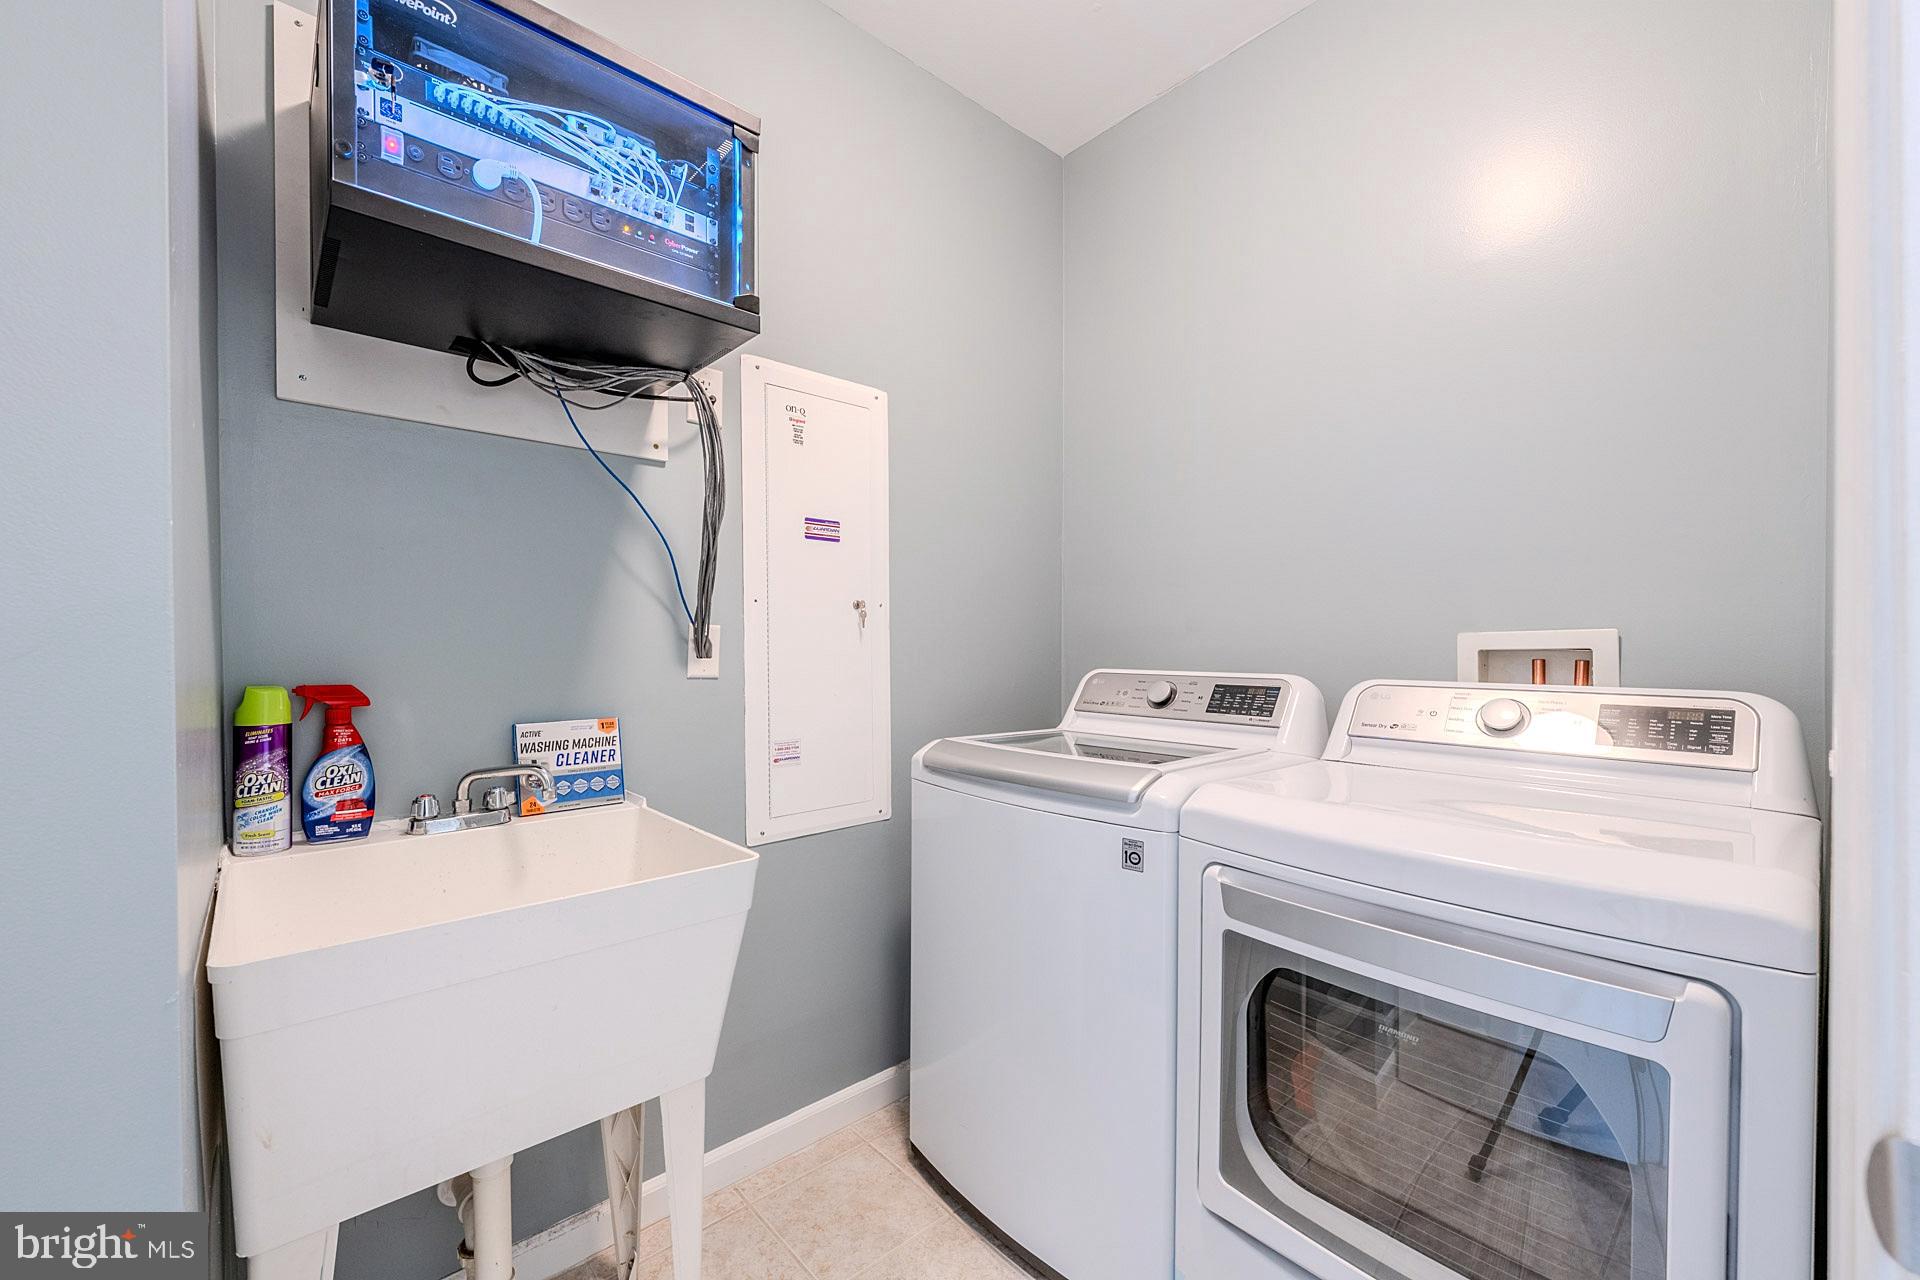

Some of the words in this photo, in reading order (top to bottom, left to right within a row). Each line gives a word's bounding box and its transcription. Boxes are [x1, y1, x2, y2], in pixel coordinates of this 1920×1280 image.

[664, 238, 699, 255] CyberPower
[1378, 722, 1387, 730] Dry
[520, 730, 542, 739] ACTIVE
[520, 739, 570, 754] WASHING
[572, 735, 617, 750] MACHINE
[556, 748, 616, 767] CLEANER
[326, 764, 354, 779] OXI
[243, 772, 273, 788] OXI
[315, 771, 362, 791] CLEAN
[236, 780, 282, 799] CLEAN
[318, 789, 335, 798] MAX
[336, 784, 361, 794] FORCE
[249, 813, 267, 822] COLOR
[1124, 850, 1141, 865] 10
